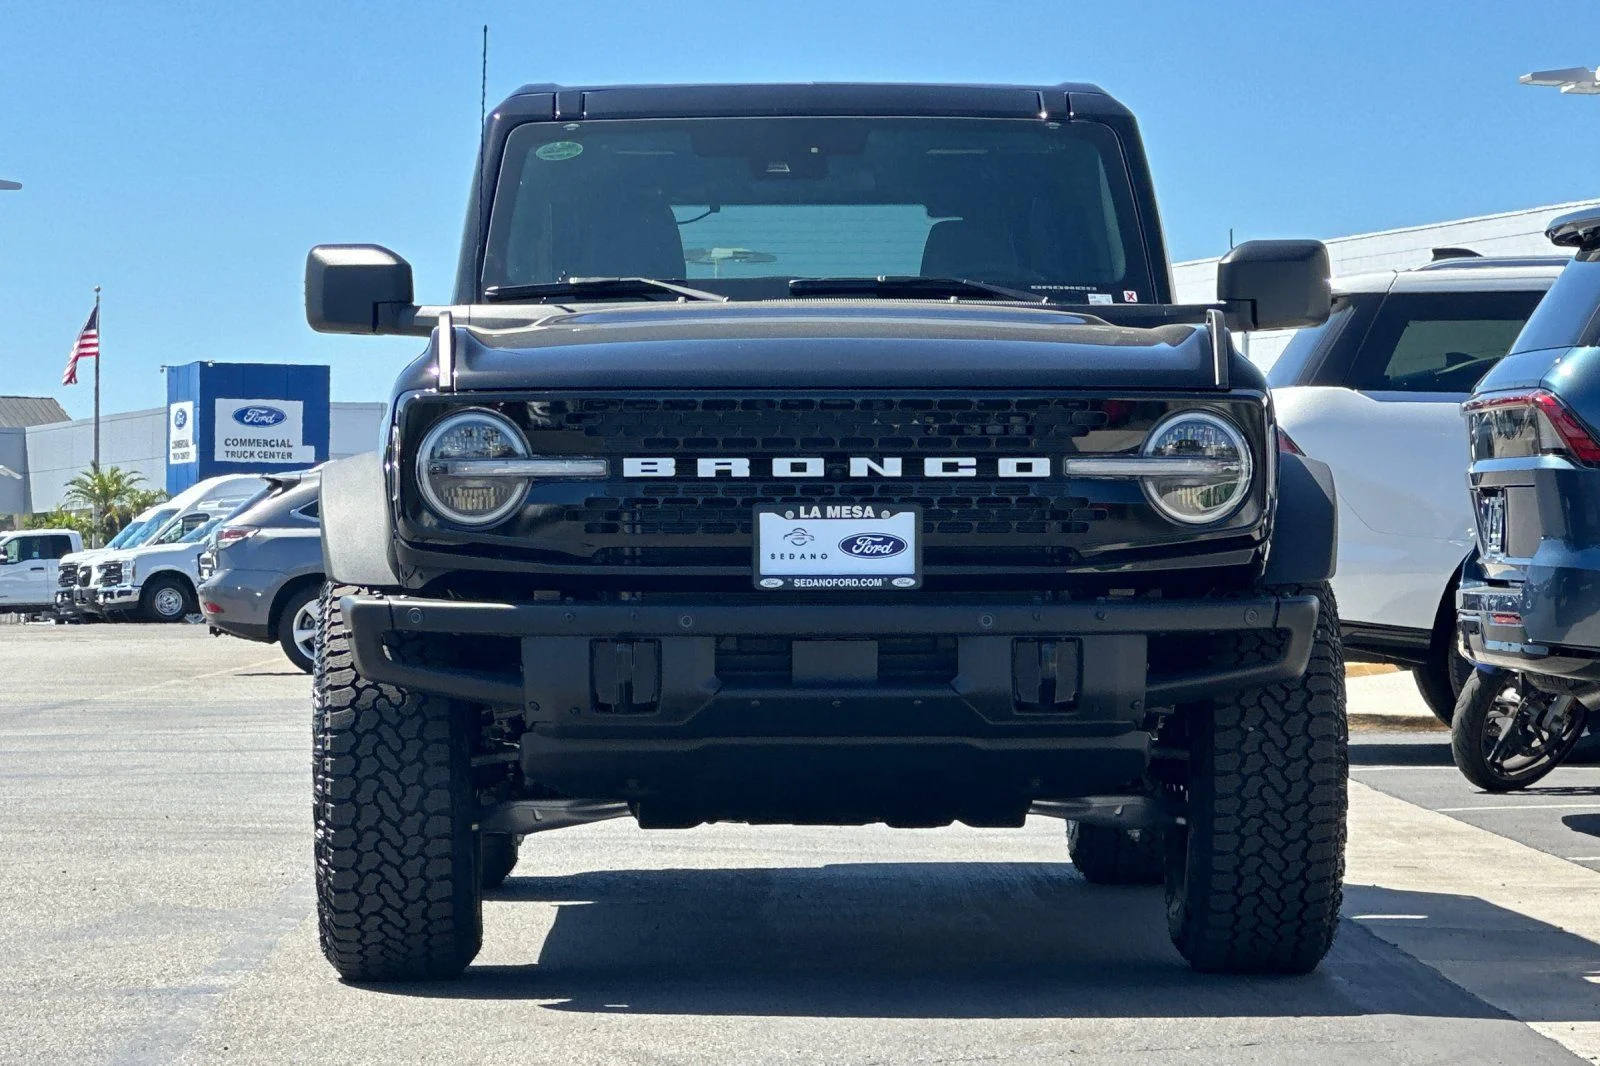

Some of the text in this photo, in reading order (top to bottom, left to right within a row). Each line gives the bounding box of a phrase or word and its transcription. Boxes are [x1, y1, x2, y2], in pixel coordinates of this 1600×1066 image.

[243, 408, 276, 424] Ford
[224, 438, 293, 448] COMMERCIAL
[225, 450, 293, 460] TRUCK CENTER
[623, 457, 1051, 477] BRONCO
[800, 505, 875, 518] LA MESA
[851, 536, 895, 554] Ford
[793, 578, 882, 587] SEDANOFORD.COM
